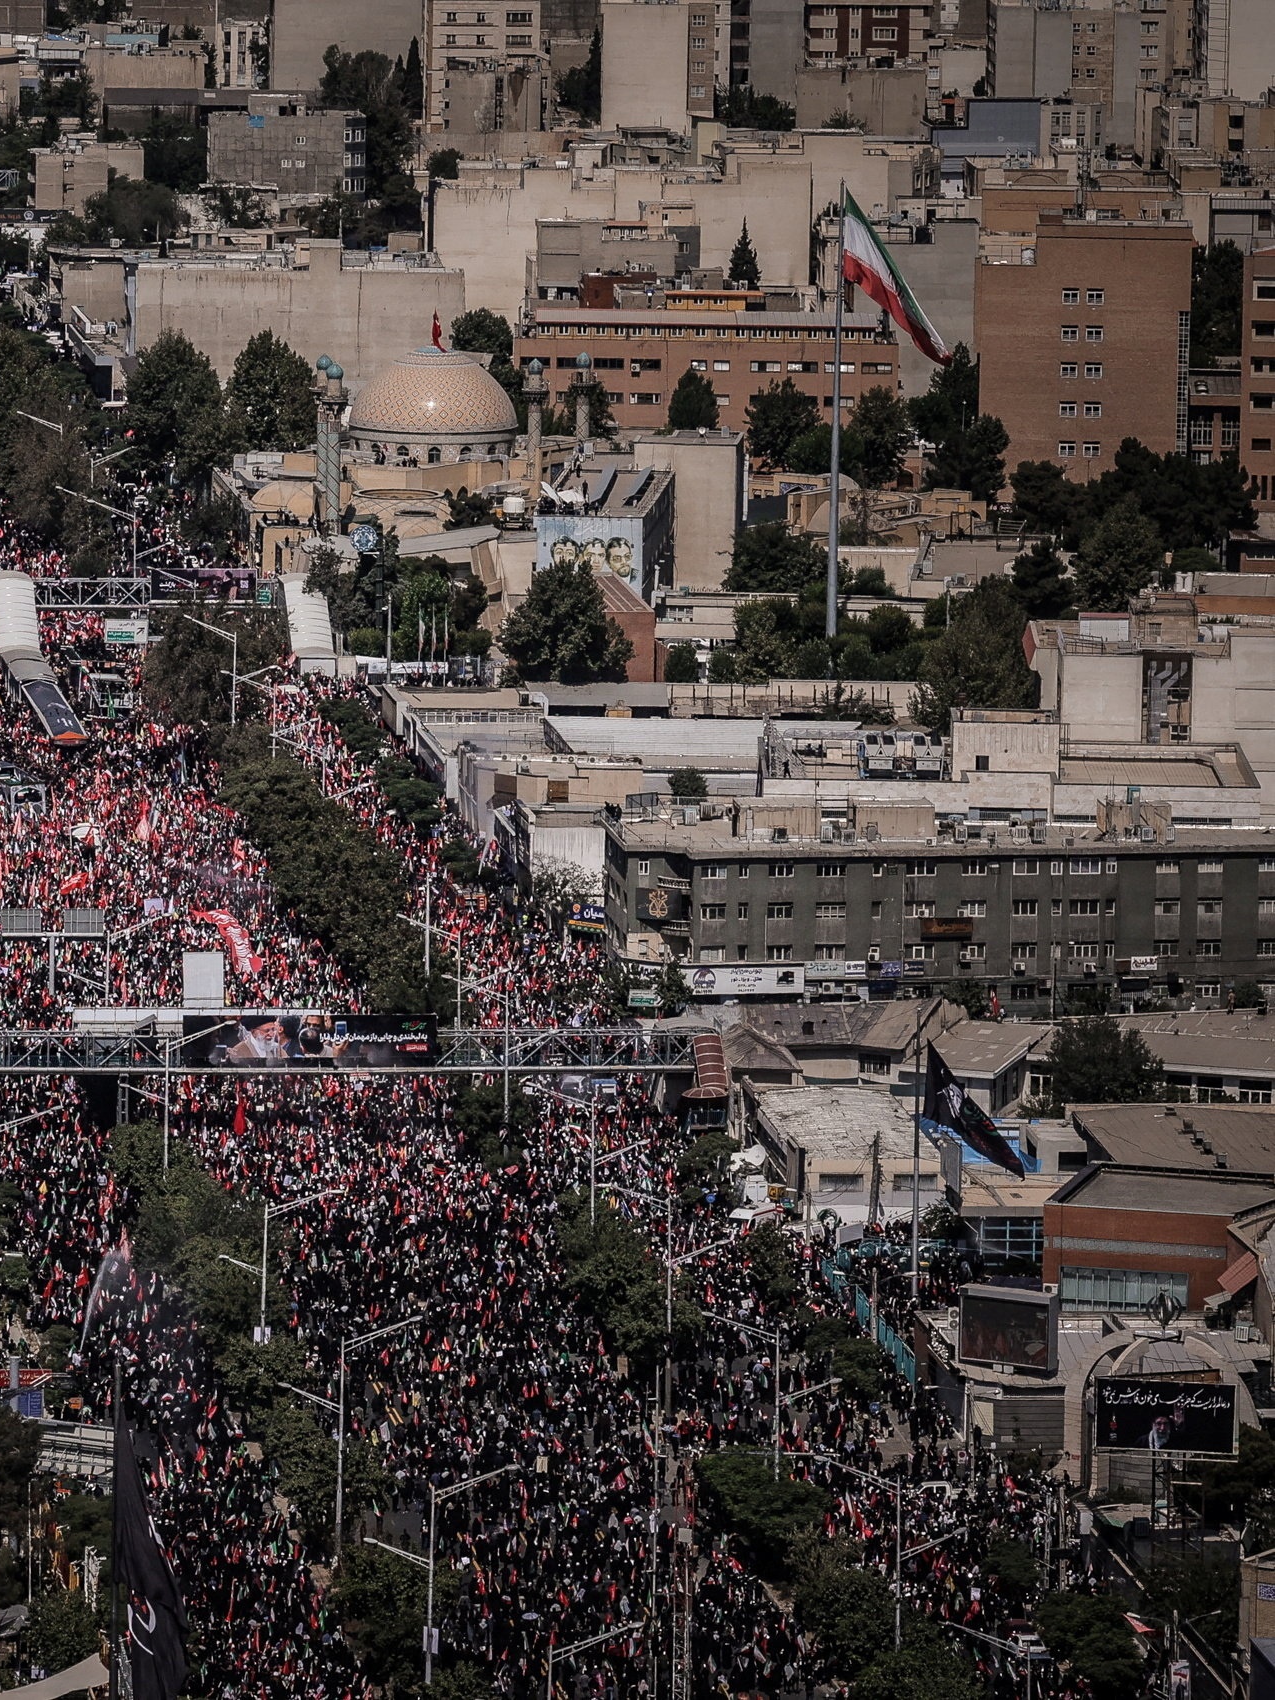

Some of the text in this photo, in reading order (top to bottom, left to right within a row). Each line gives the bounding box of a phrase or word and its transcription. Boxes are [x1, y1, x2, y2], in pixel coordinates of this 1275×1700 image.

[340, 1033, 350, 1042] کن
[349, 1033, 370, 1042] مهمان
[378, 1032, 393, 1043] چایی
[398, 1032, 421, 1042] لبخندی
[422, 1033, 428, 1042] به
[1138, 1390, 1153, 1405] خون
